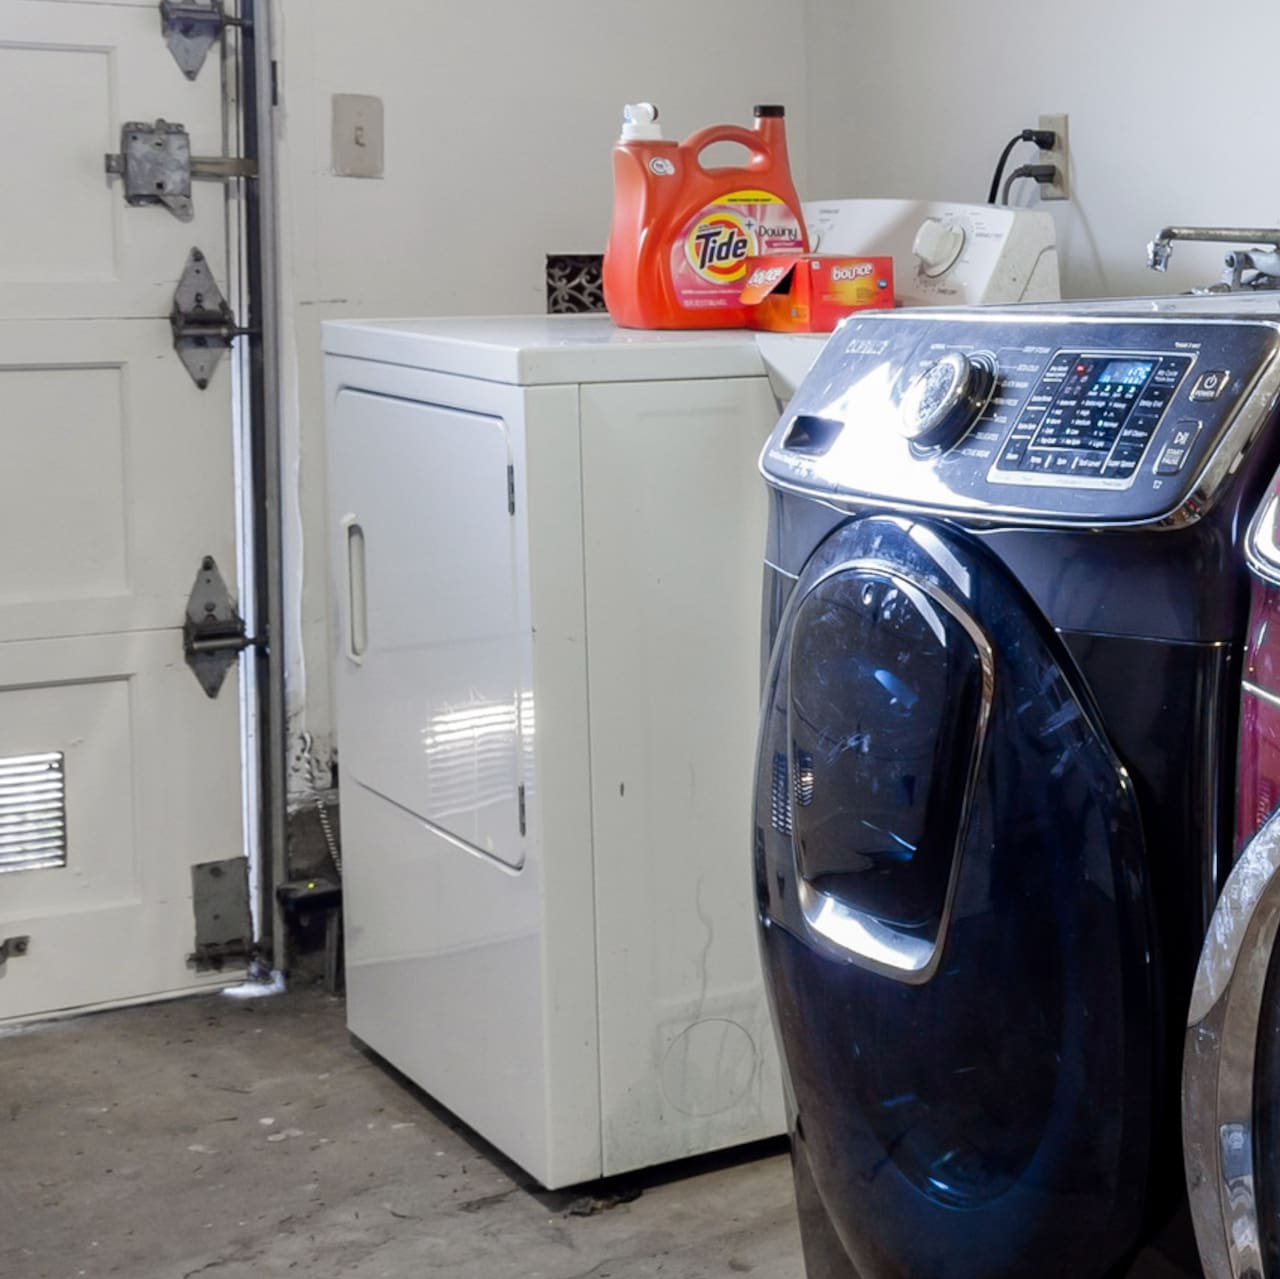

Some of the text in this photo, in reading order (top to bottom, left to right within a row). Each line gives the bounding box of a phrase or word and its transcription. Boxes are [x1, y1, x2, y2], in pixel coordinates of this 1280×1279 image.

[758, 225, 798, 240] Downy
[695, 230, 748, 270] Tide
[832, 263, 874, 281] bounce
